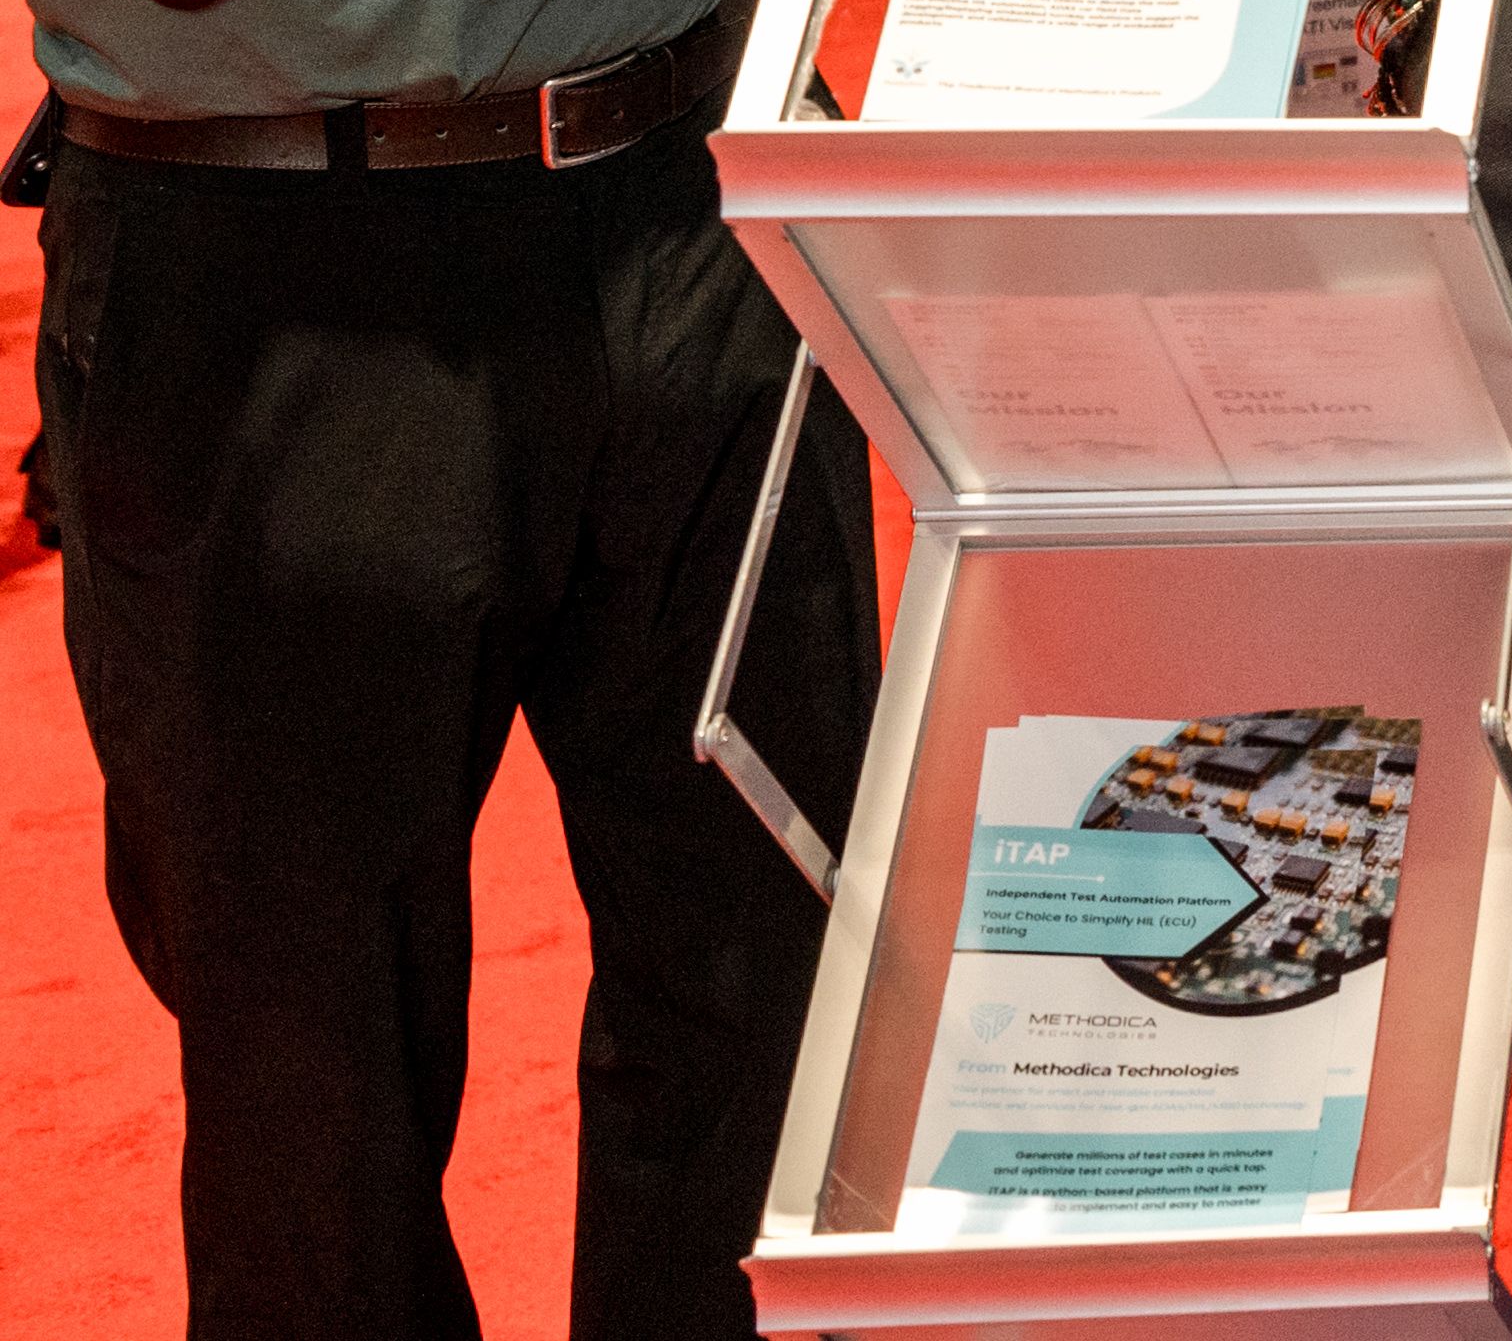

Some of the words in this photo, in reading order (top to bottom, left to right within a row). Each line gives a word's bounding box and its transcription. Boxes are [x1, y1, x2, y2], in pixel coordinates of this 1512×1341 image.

[994, 839, 1070, 865] iTAP
[986, 889, 1066, 902] Independent
[1070, 892, 1096, 902] Test
[1100, 894, 1174, 906] Automation
[1177, 897, 1231, 907] Platform
[982, 910, 1011, 920] Your
[1014, 910, 1062, 922] Choice
[1065, 912, 1077, 923] to
[1082, 913, 1133, 927] Simplify
[1136, 916, 1154, 926] HIL
[1158, 915, 1197, 928] (ECU)
[979, 924, 1028, 938] Testing
[1028, 1013, 1157, 1029] METHODICA
[957, 1060, 1006, 1074] From
[1012, 1062, 1112, 1077] Methodica
[1116, 1063, 1240, 1079] Technologies
[1015, 1150, 1074, 1161] Generate
[1142, 1150, 1167, 1160] test
[1223, 1148, 1273, 1159] minutes
